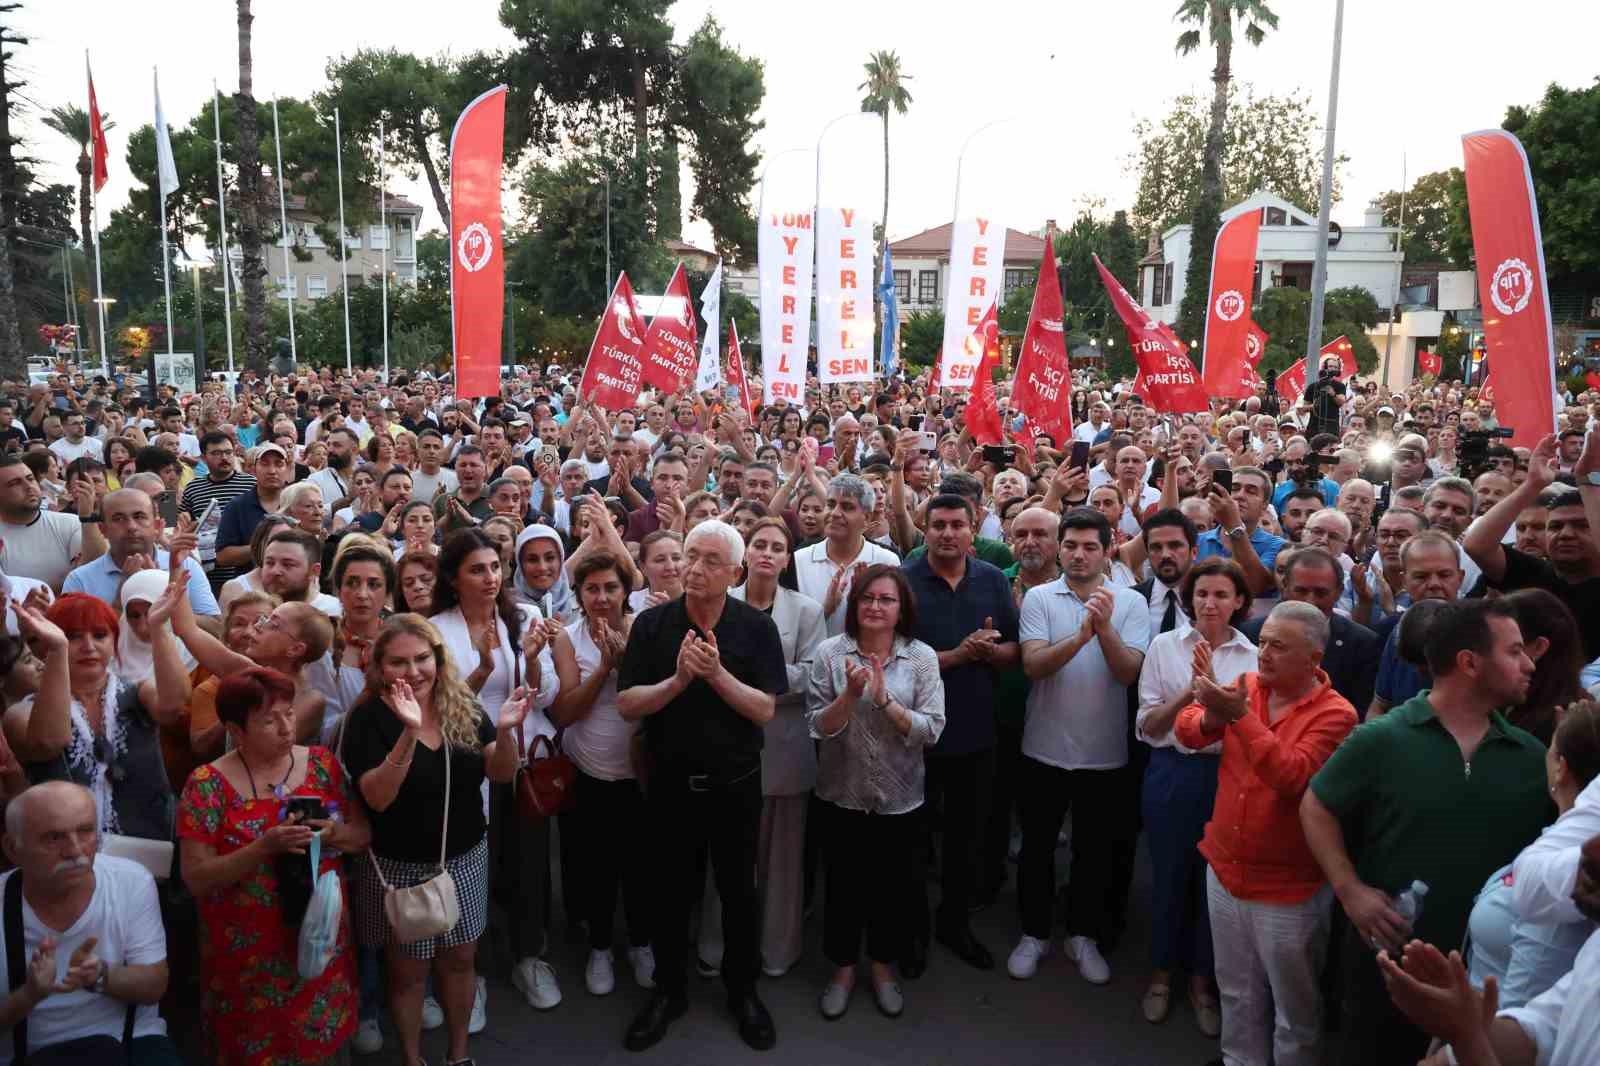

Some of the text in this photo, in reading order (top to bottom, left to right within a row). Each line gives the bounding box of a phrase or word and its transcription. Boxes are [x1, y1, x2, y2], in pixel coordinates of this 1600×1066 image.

[840, 207, 857, 350] YEREL
[778, 236, 798, 373] YEREL
[829, 359, 868, 375] SEN
[1146, 370, 1194, 386] PARTİSİ
[596, 372, 637, 394] PARTİSİ
